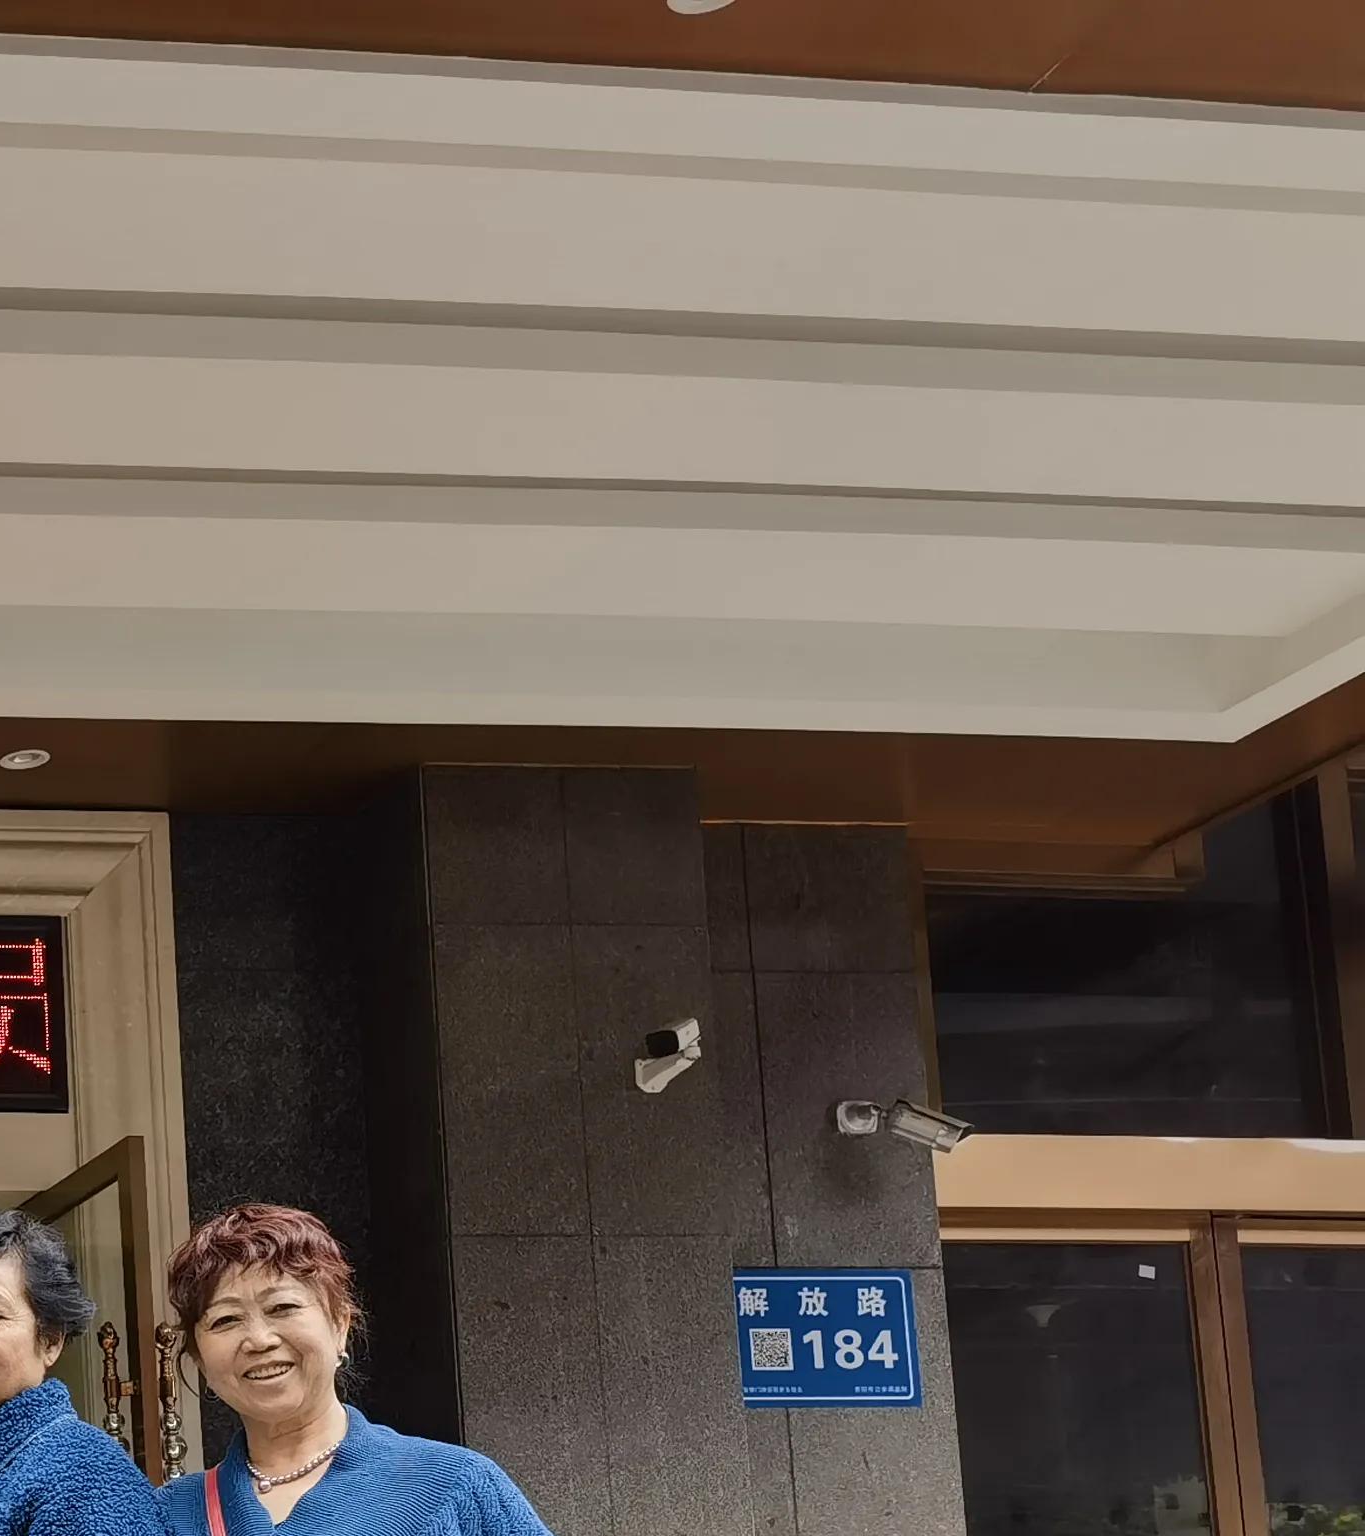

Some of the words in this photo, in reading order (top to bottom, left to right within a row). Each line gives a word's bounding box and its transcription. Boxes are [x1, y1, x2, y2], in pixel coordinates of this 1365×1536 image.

[737, 1286, 887, 1317] 解放路
[802, 1329, 899, 1370] 184
